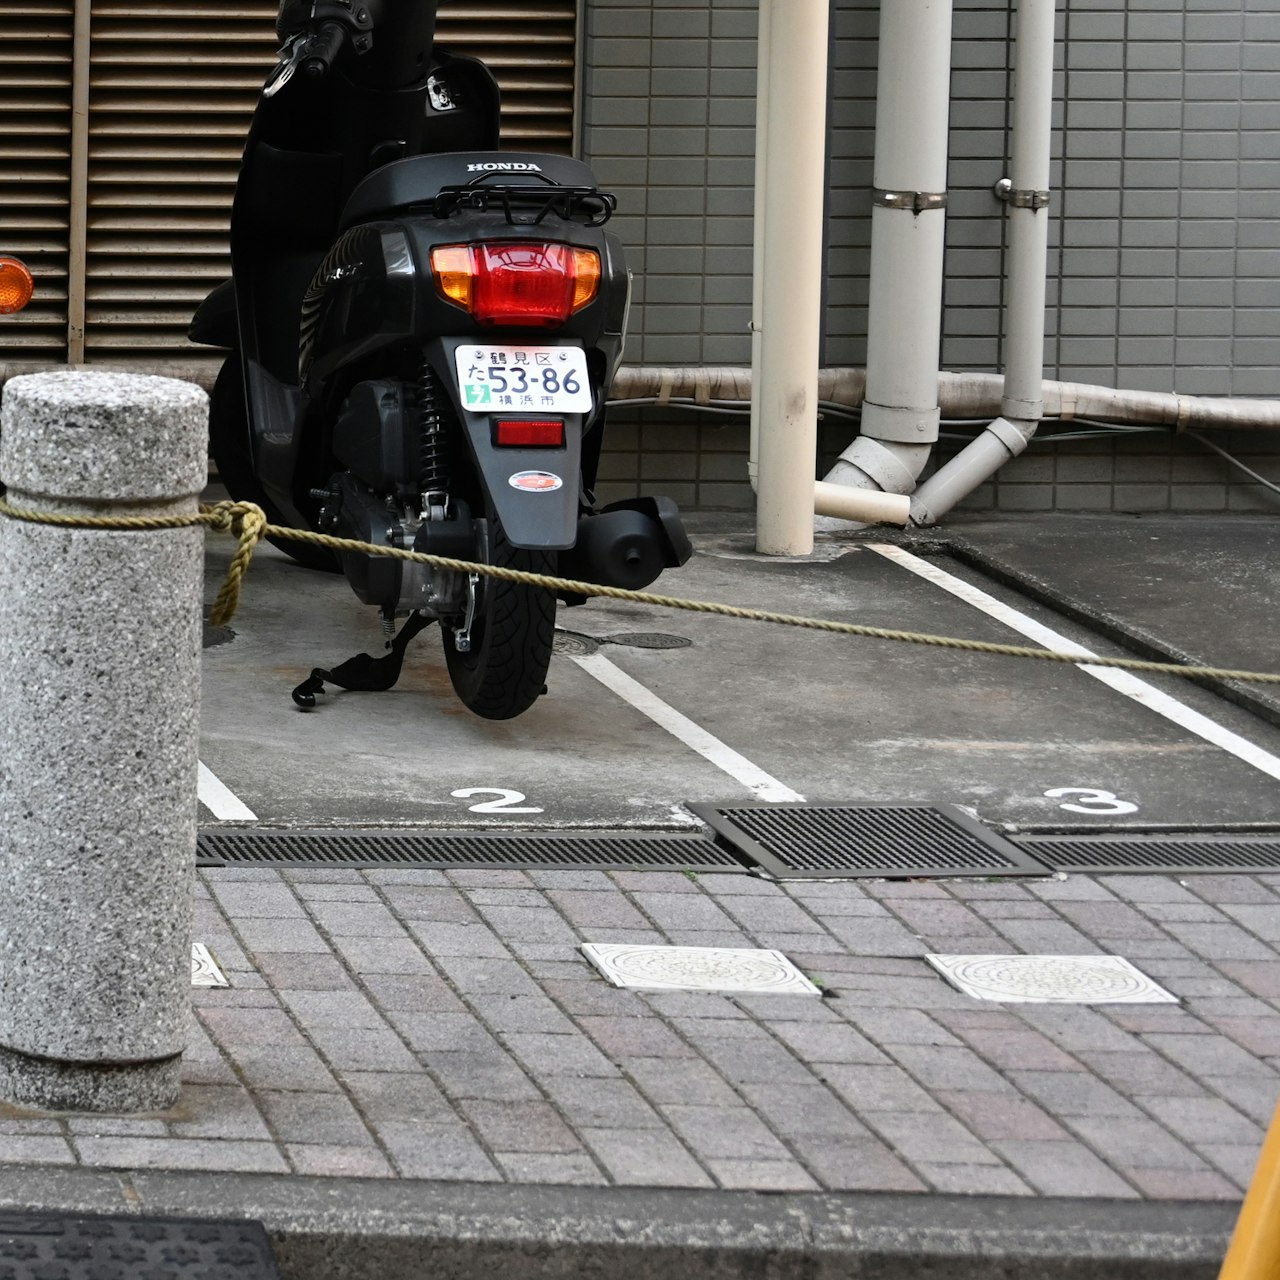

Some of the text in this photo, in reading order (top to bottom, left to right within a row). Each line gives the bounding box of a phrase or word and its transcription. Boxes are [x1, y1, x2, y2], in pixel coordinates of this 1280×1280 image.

[467, 162, 542, 172] HONDA
[490, 351, 553, 365] 鶴見区
[488, 366, 581, 394] 53-86
[499, 395, 555, 406] 横浜市
[450, 787, 545, 814] 2
[1043, 787, 1139, 815] 3
